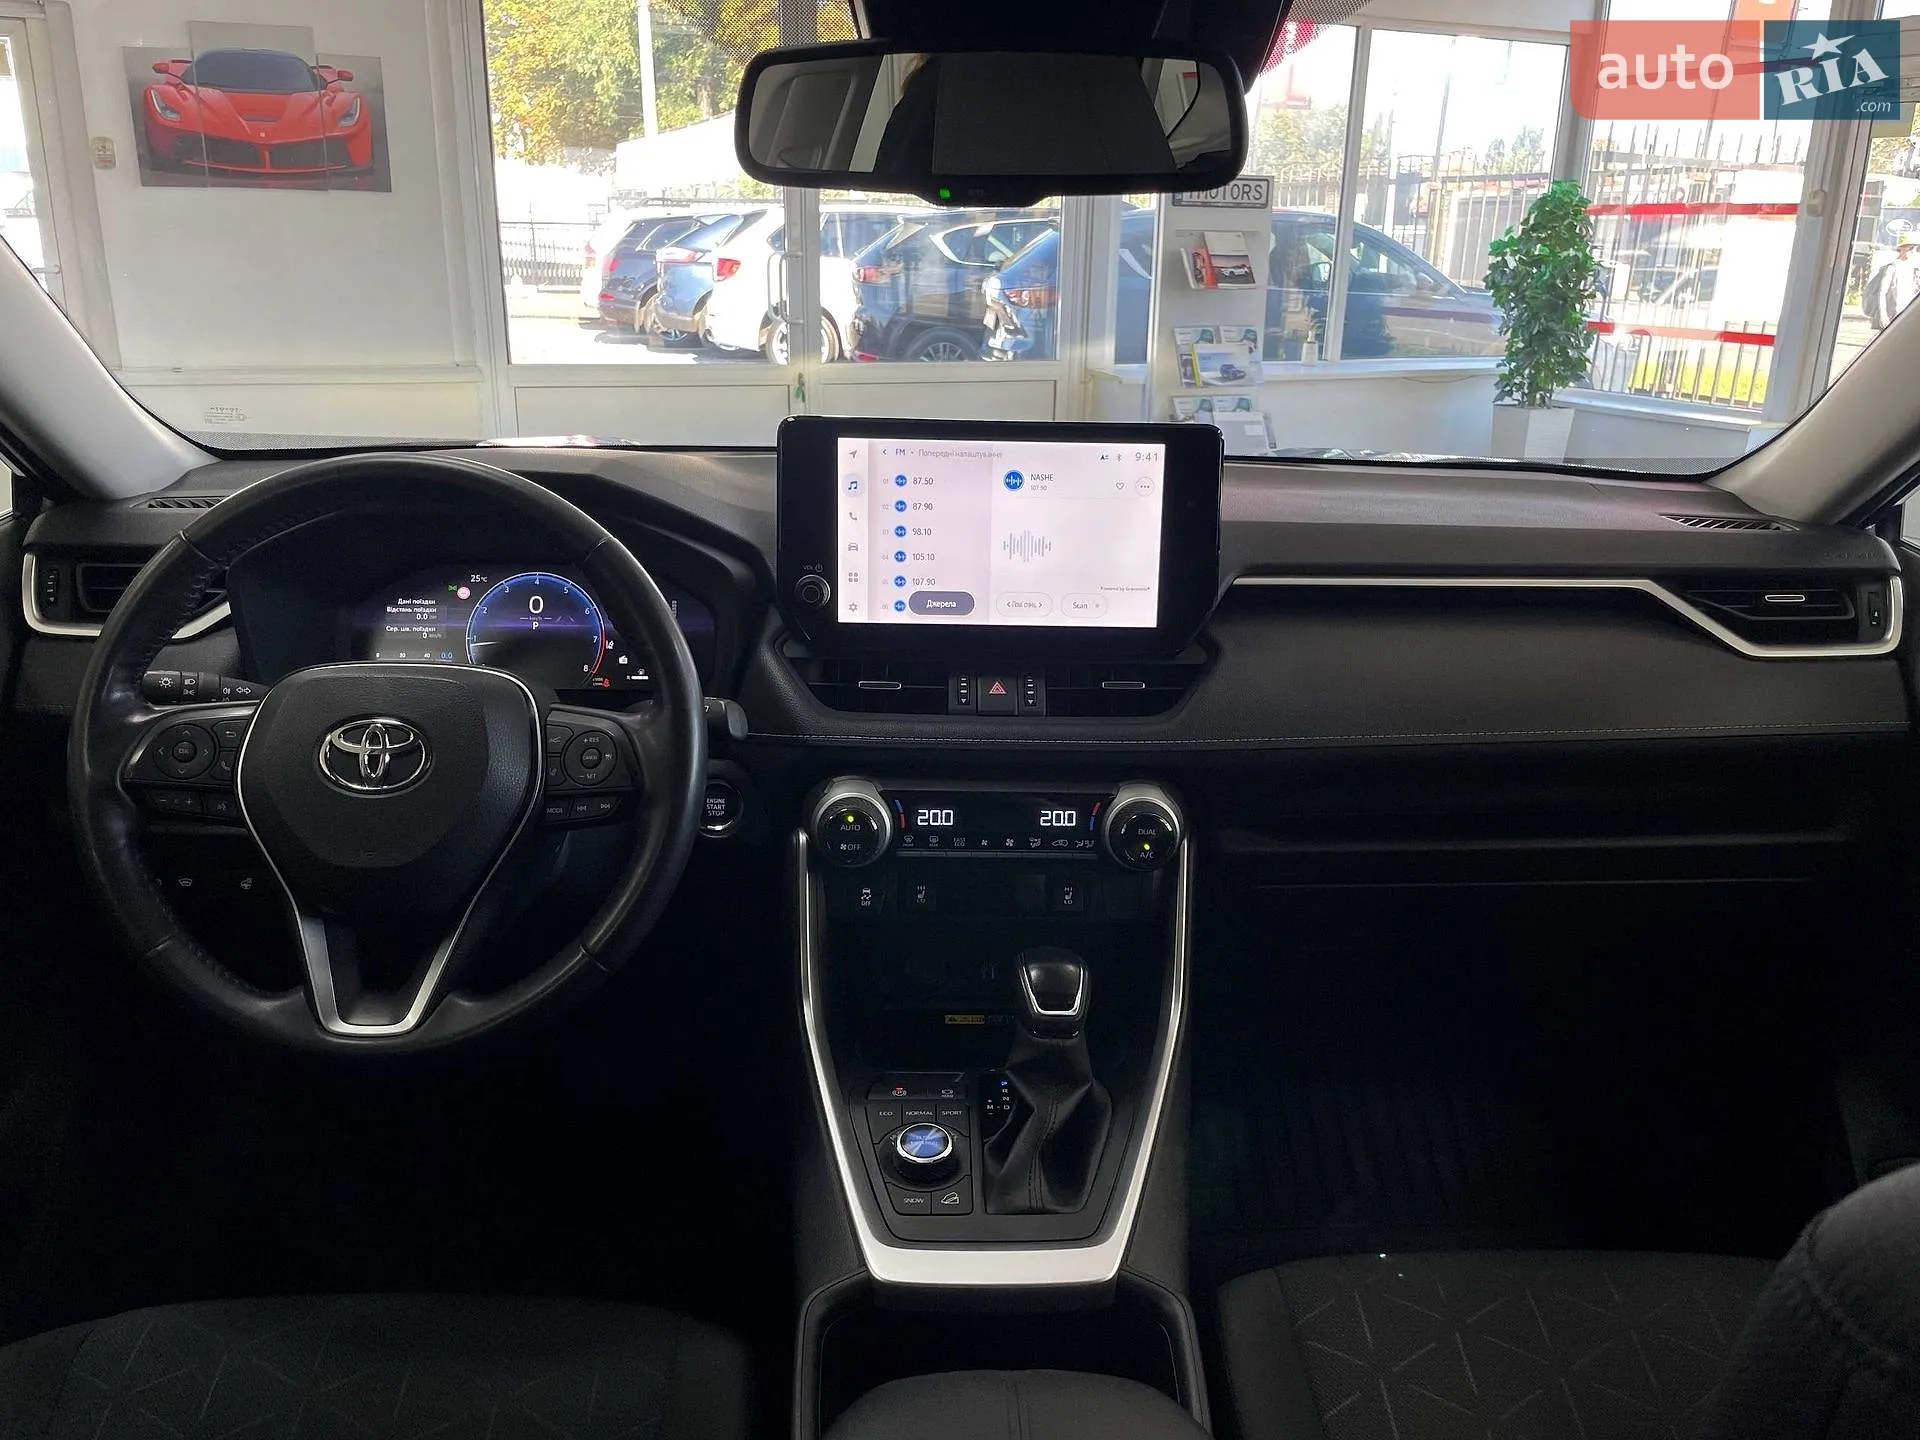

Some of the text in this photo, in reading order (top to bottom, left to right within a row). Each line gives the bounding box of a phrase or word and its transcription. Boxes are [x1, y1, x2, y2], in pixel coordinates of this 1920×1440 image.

[1135, 452, 1159, 462] 9:41
[912, 477, 934, 485] 87.50
[912, 502, 933, 510] 87.90
[529, 596, 544, 614] 0
[926, 600, 957, 608] Джерела
